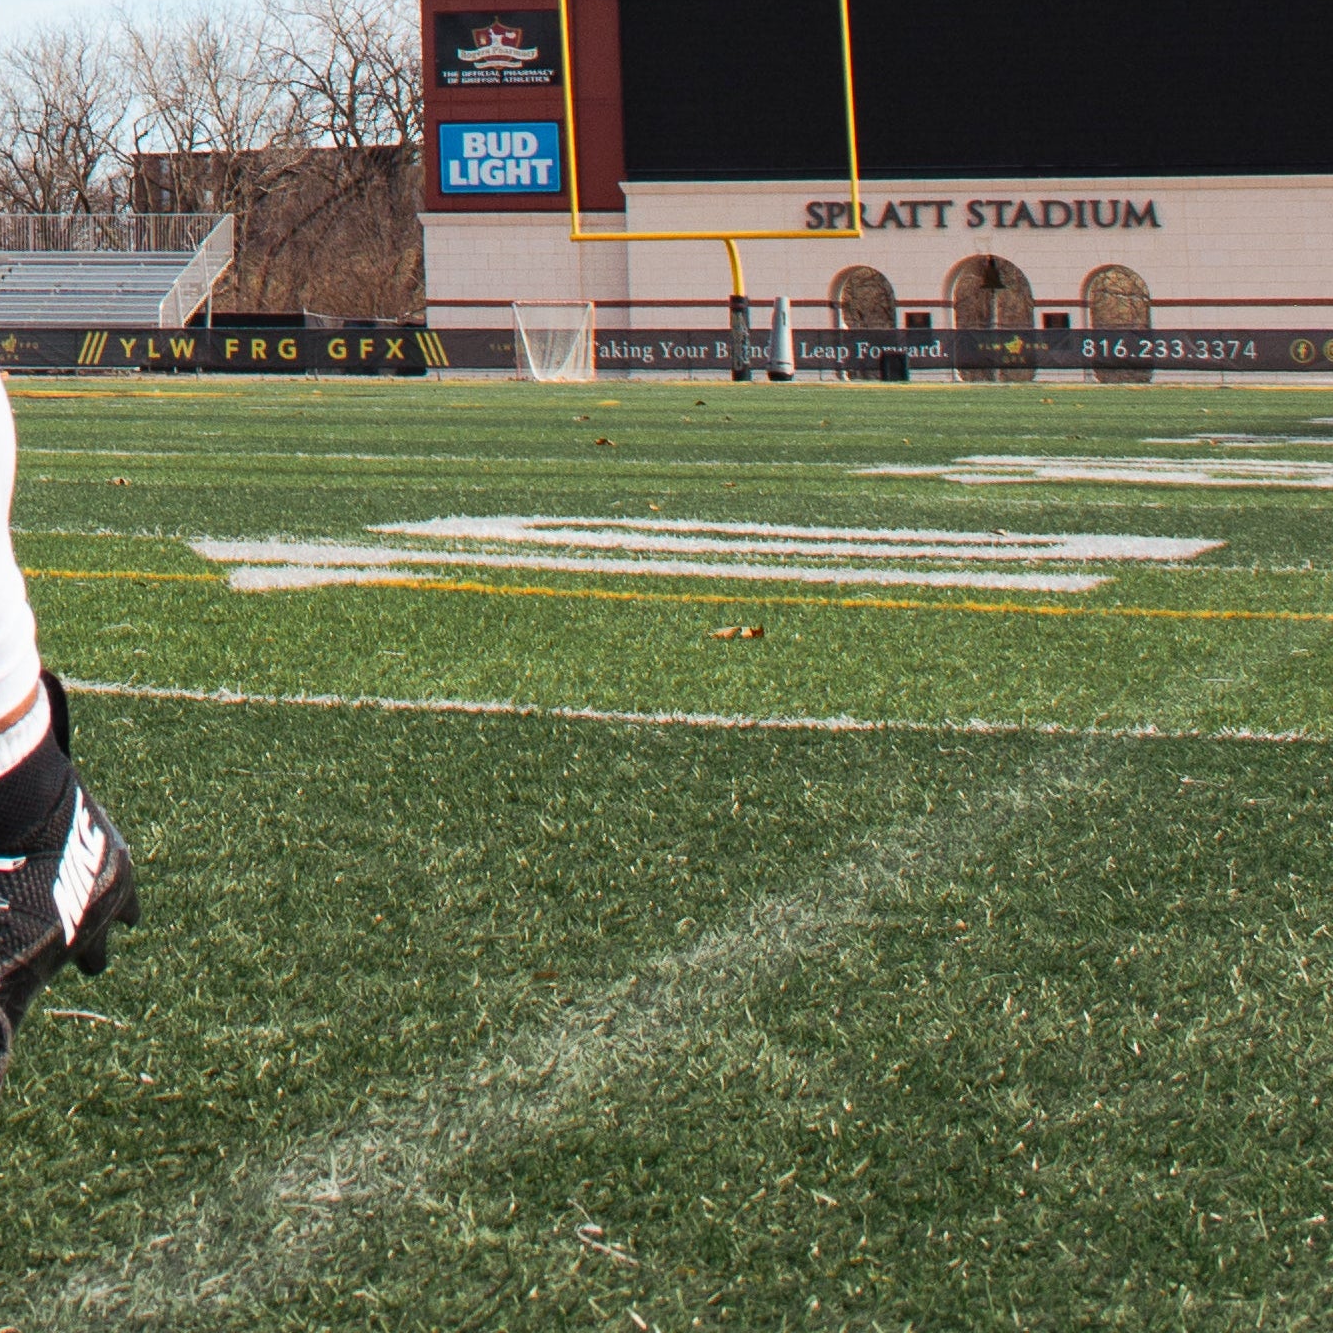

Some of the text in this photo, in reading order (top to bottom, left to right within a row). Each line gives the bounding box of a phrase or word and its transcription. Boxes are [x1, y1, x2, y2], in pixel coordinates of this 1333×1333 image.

[462, 131, 539, 159] BUD
[448, 158, 553, 186] LIGHT
[805, 199, 1161, 230] SPRATT STADIUM
[119, 338, 405, 359] YLW FRG GFX
[659, 341, 709, 359] Your
[800, 341, 848, 363] Leap
[1082, 338, 1260, 360] 816.233.3374
